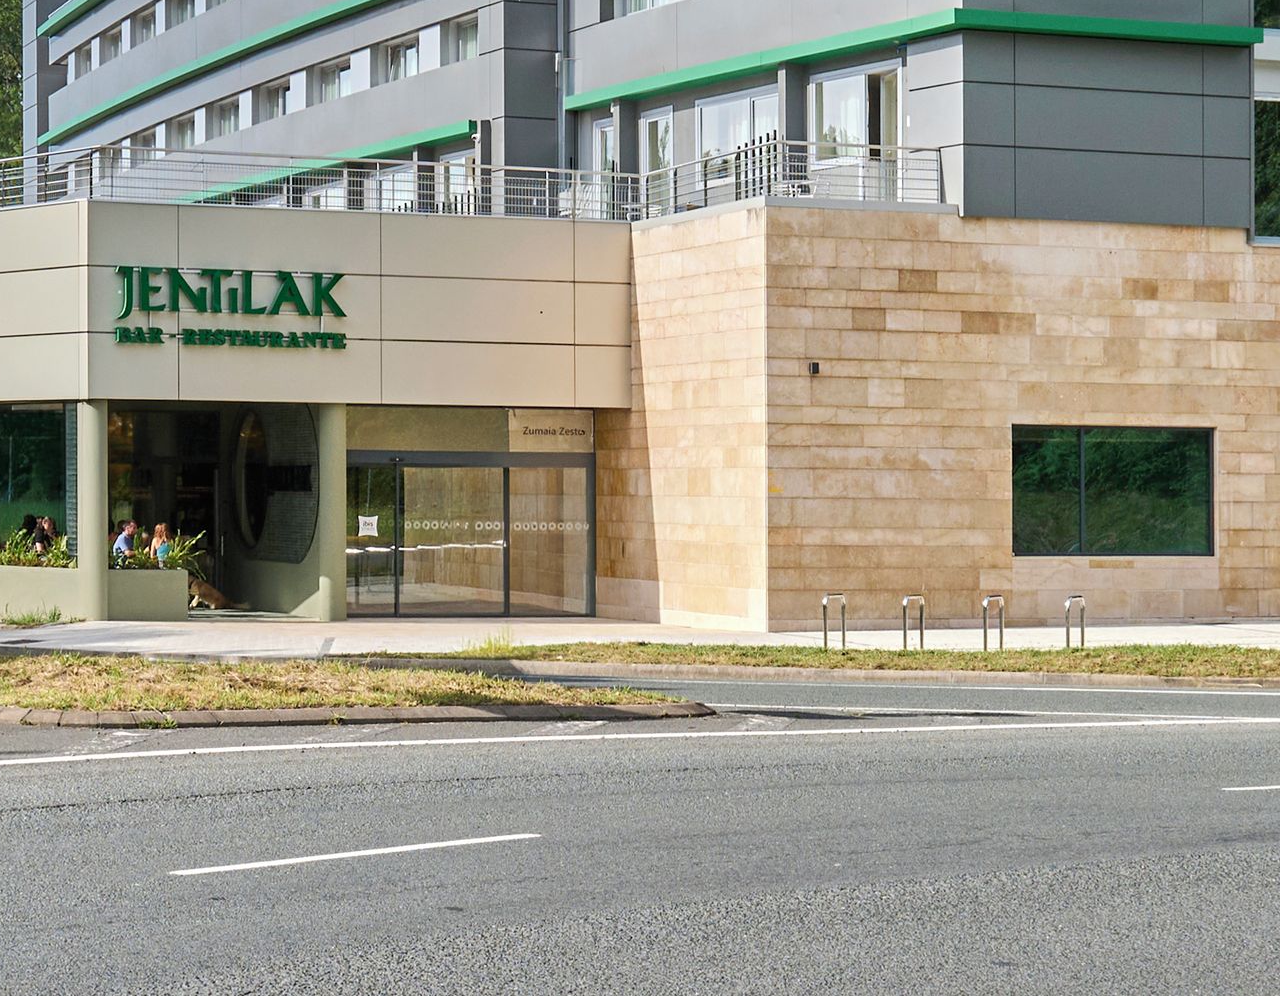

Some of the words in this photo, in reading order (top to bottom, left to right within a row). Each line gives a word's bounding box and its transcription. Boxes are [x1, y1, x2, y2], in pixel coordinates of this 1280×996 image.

[115, 327, 165, 344] BAR
[182, 328, 347, 350] RESTAURANTE
[522, 426, 556, 435] Zumaia
